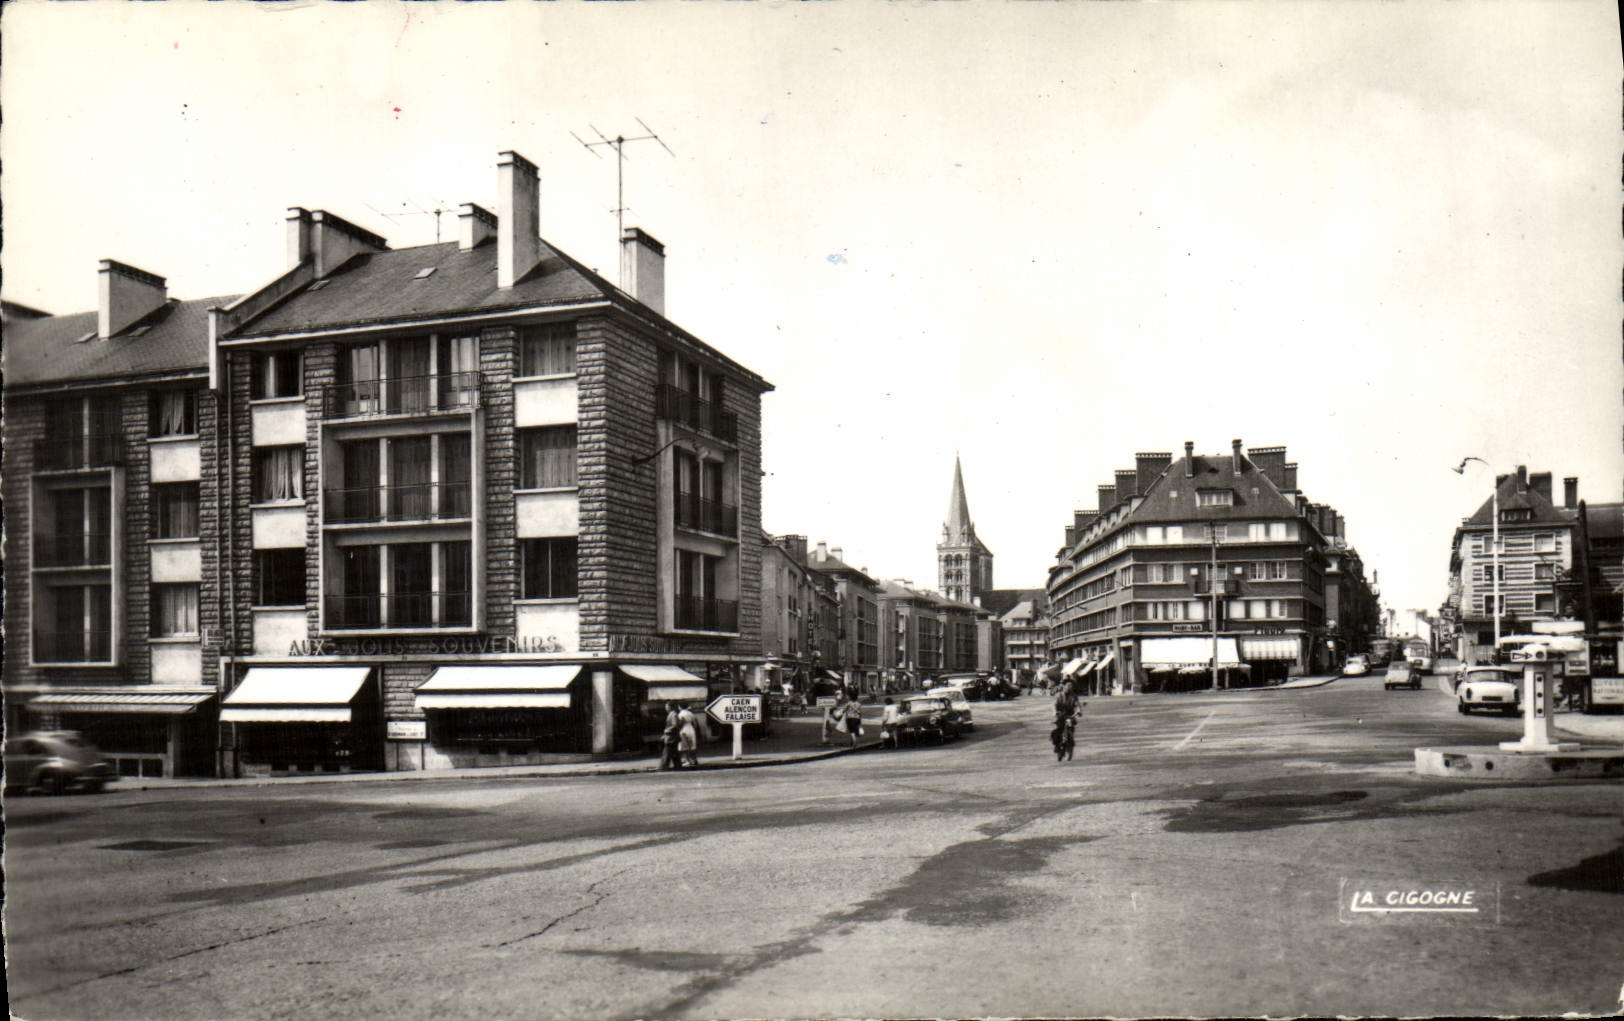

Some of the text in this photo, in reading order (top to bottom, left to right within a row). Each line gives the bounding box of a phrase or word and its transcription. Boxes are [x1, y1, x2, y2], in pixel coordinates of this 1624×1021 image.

[288, 636, 558, 656] AUX JOLIS SOUVENIRS
[731, 698, 751, 706] CAEN
